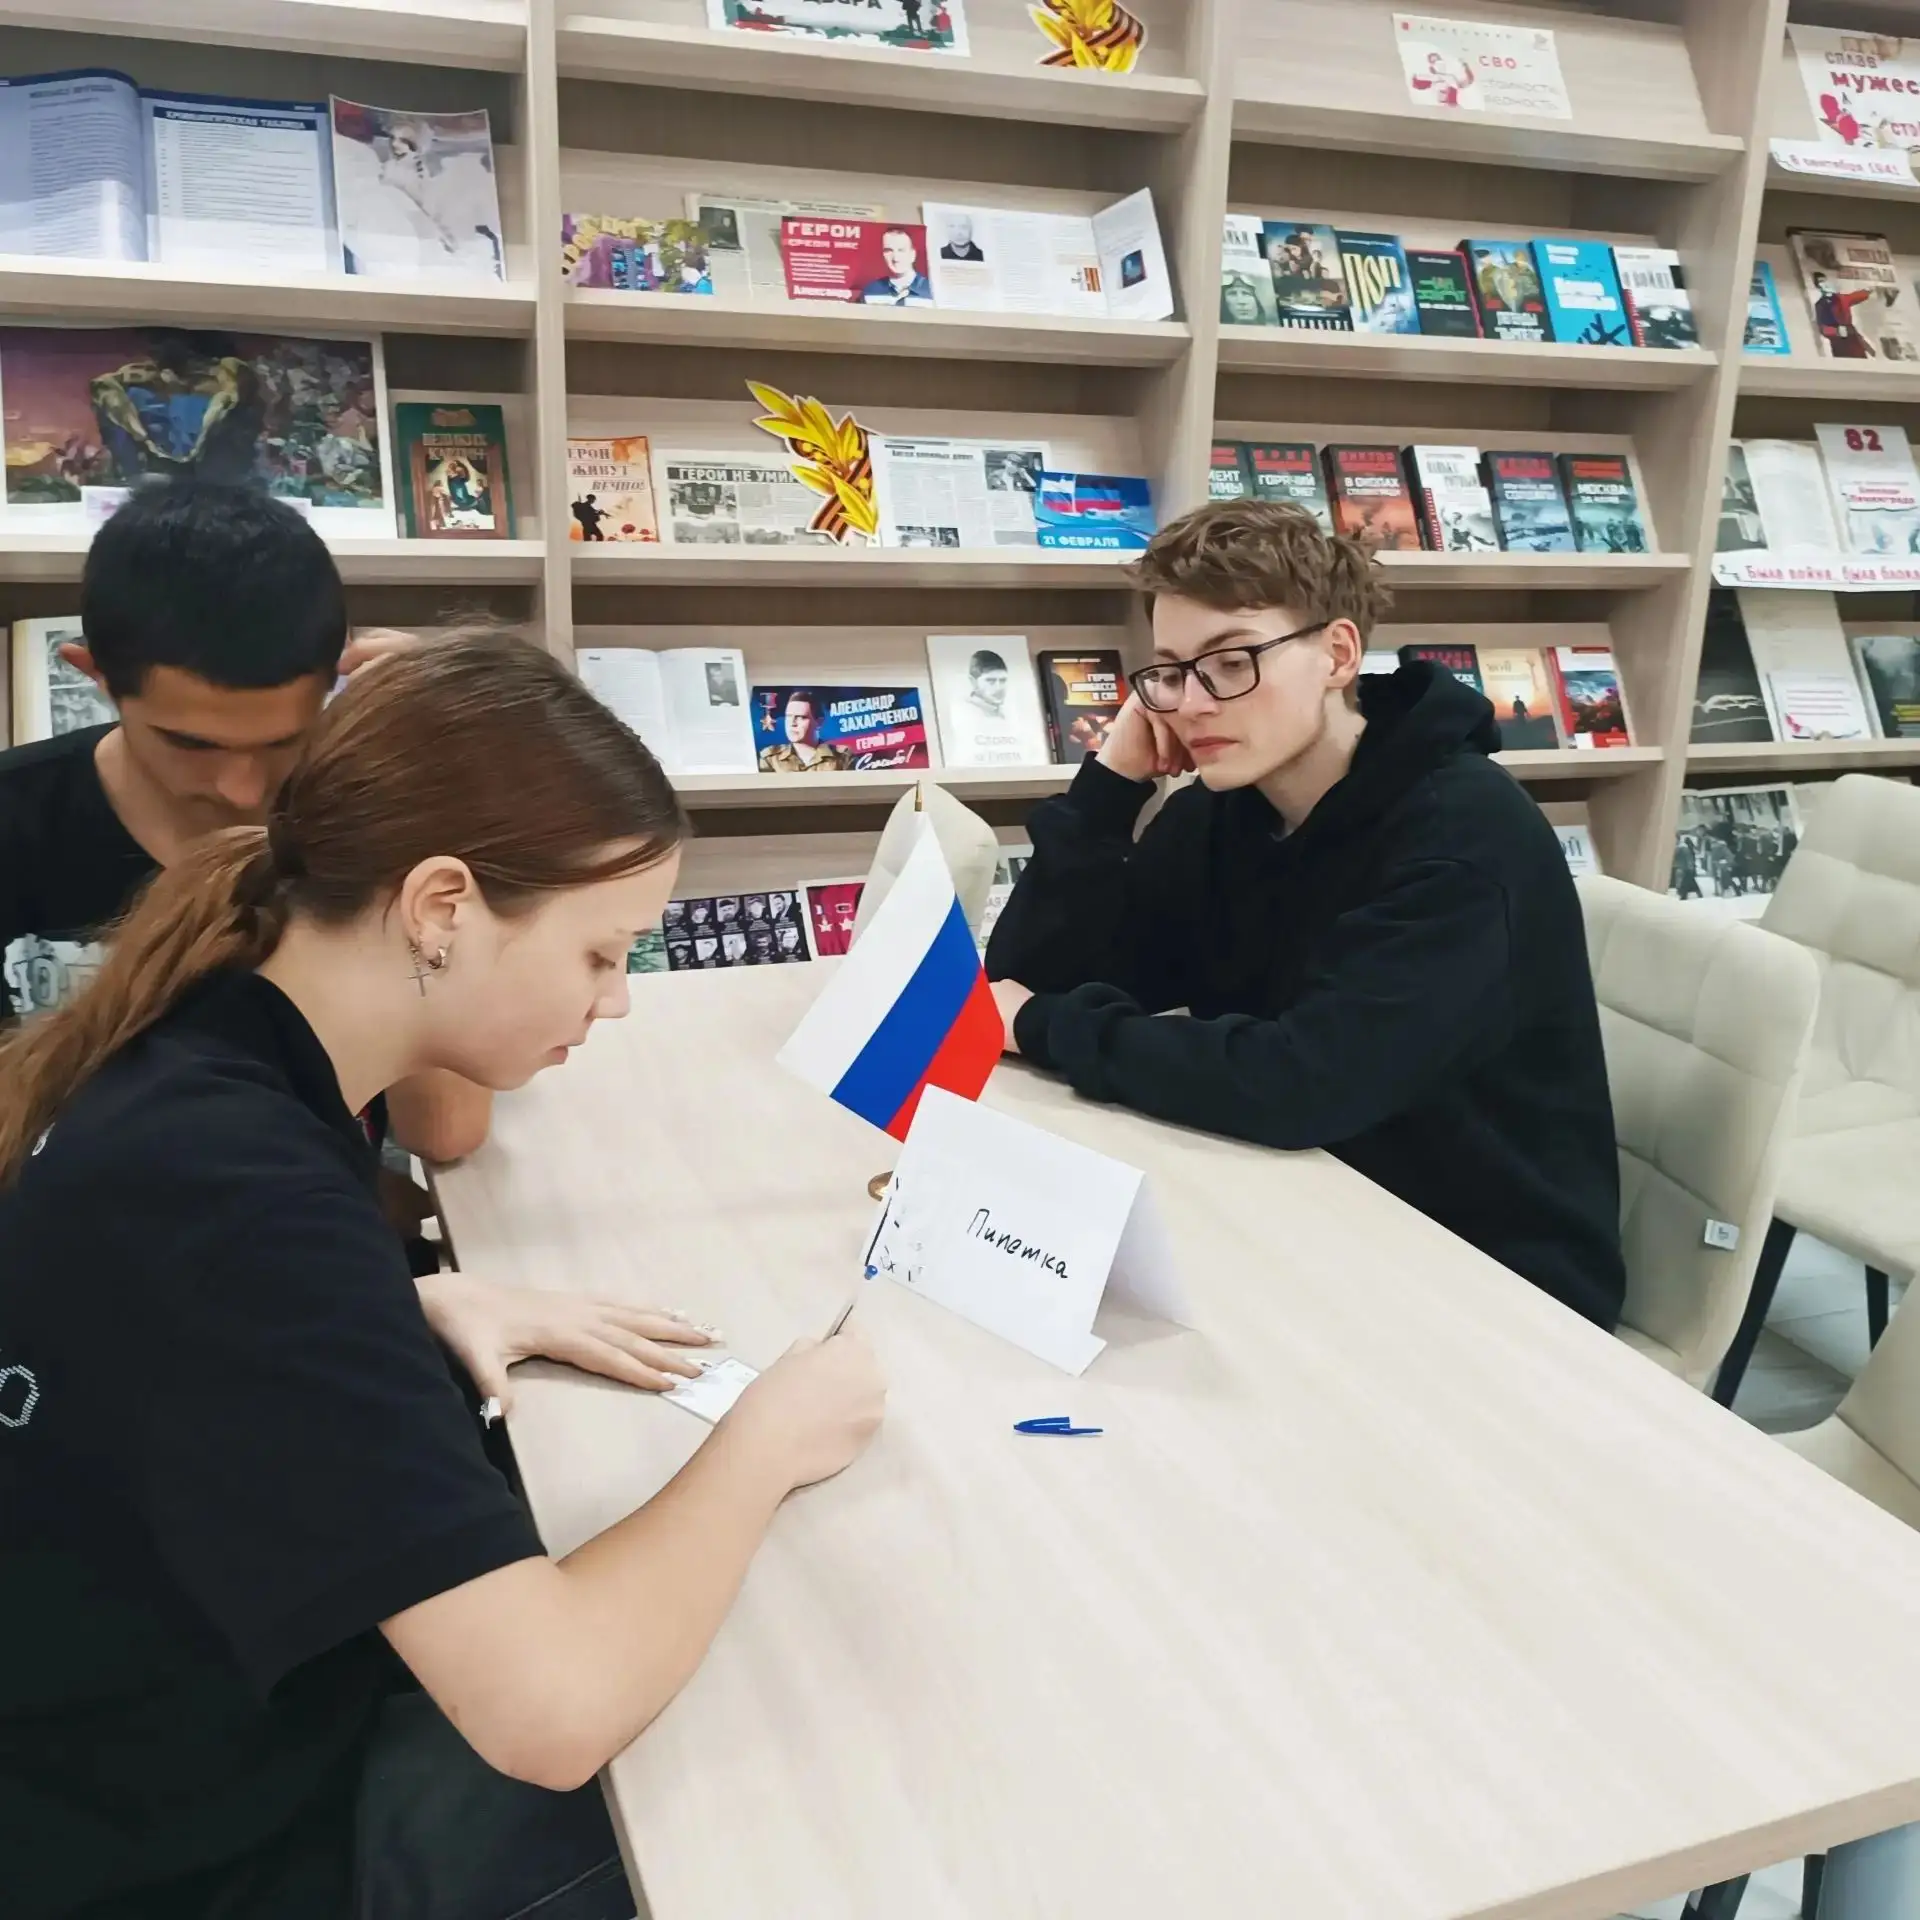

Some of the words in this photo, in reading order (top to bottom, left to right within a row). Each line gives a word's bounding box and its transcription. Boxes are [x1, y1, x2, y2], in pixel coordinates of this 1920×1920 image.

[787, 221, 861, 239] ГЕРОИ
[1844, 428, 1885, 452] 82
[678, 468, 728, 481] ГЕРОИ
[731, 469, 752, 482] НЕ
[1058, 535, 1120, 547] ФЕВРАЛЯ
[829, 693, 896, 718] АЛЕКСАНДР
[838, 705, 919, 733] ЗАХАРЧЕНКО
[966, 1207, 1069, 1279] Пипетка
